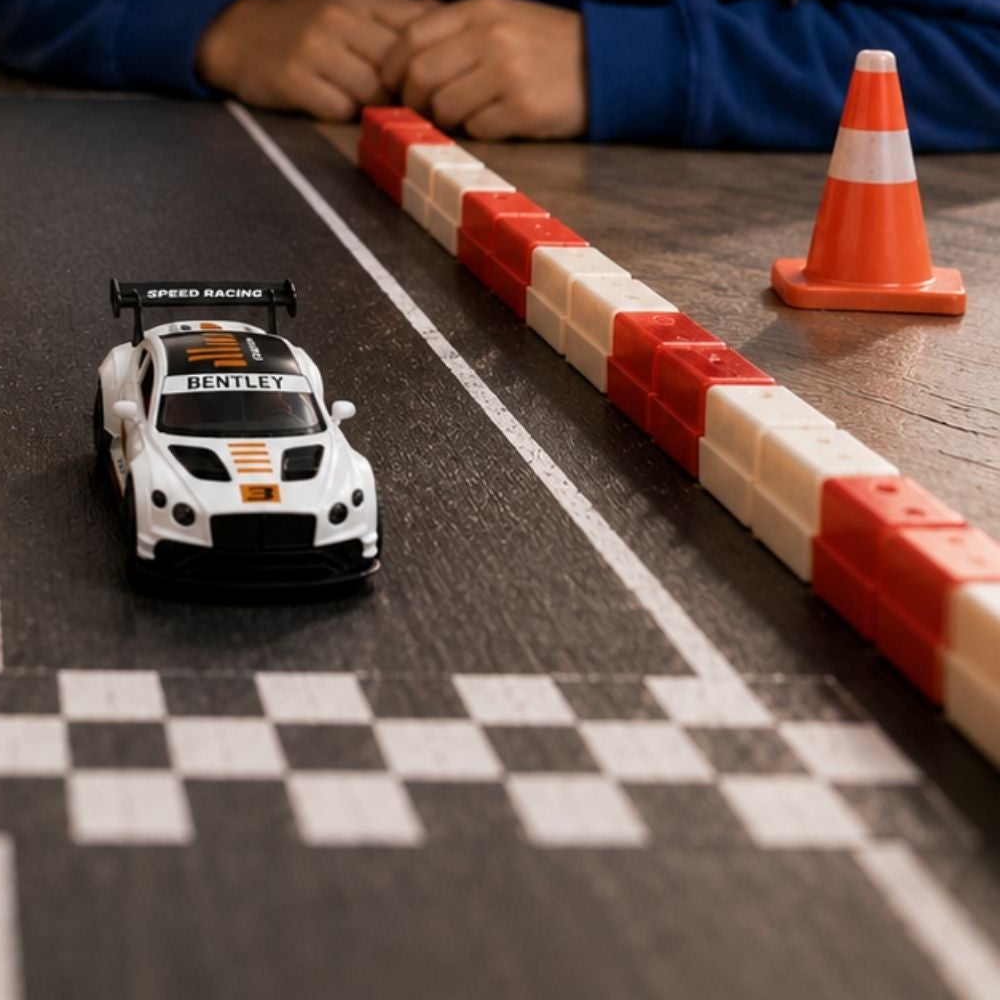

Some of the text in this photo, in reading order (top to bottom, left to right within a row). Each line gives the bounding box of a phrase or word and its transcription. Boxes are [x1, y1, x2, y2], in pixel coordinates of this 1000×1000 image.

[147, 289, 263, 298] SPEED RACING
[187, 375, 284, 390] BENTLEY
